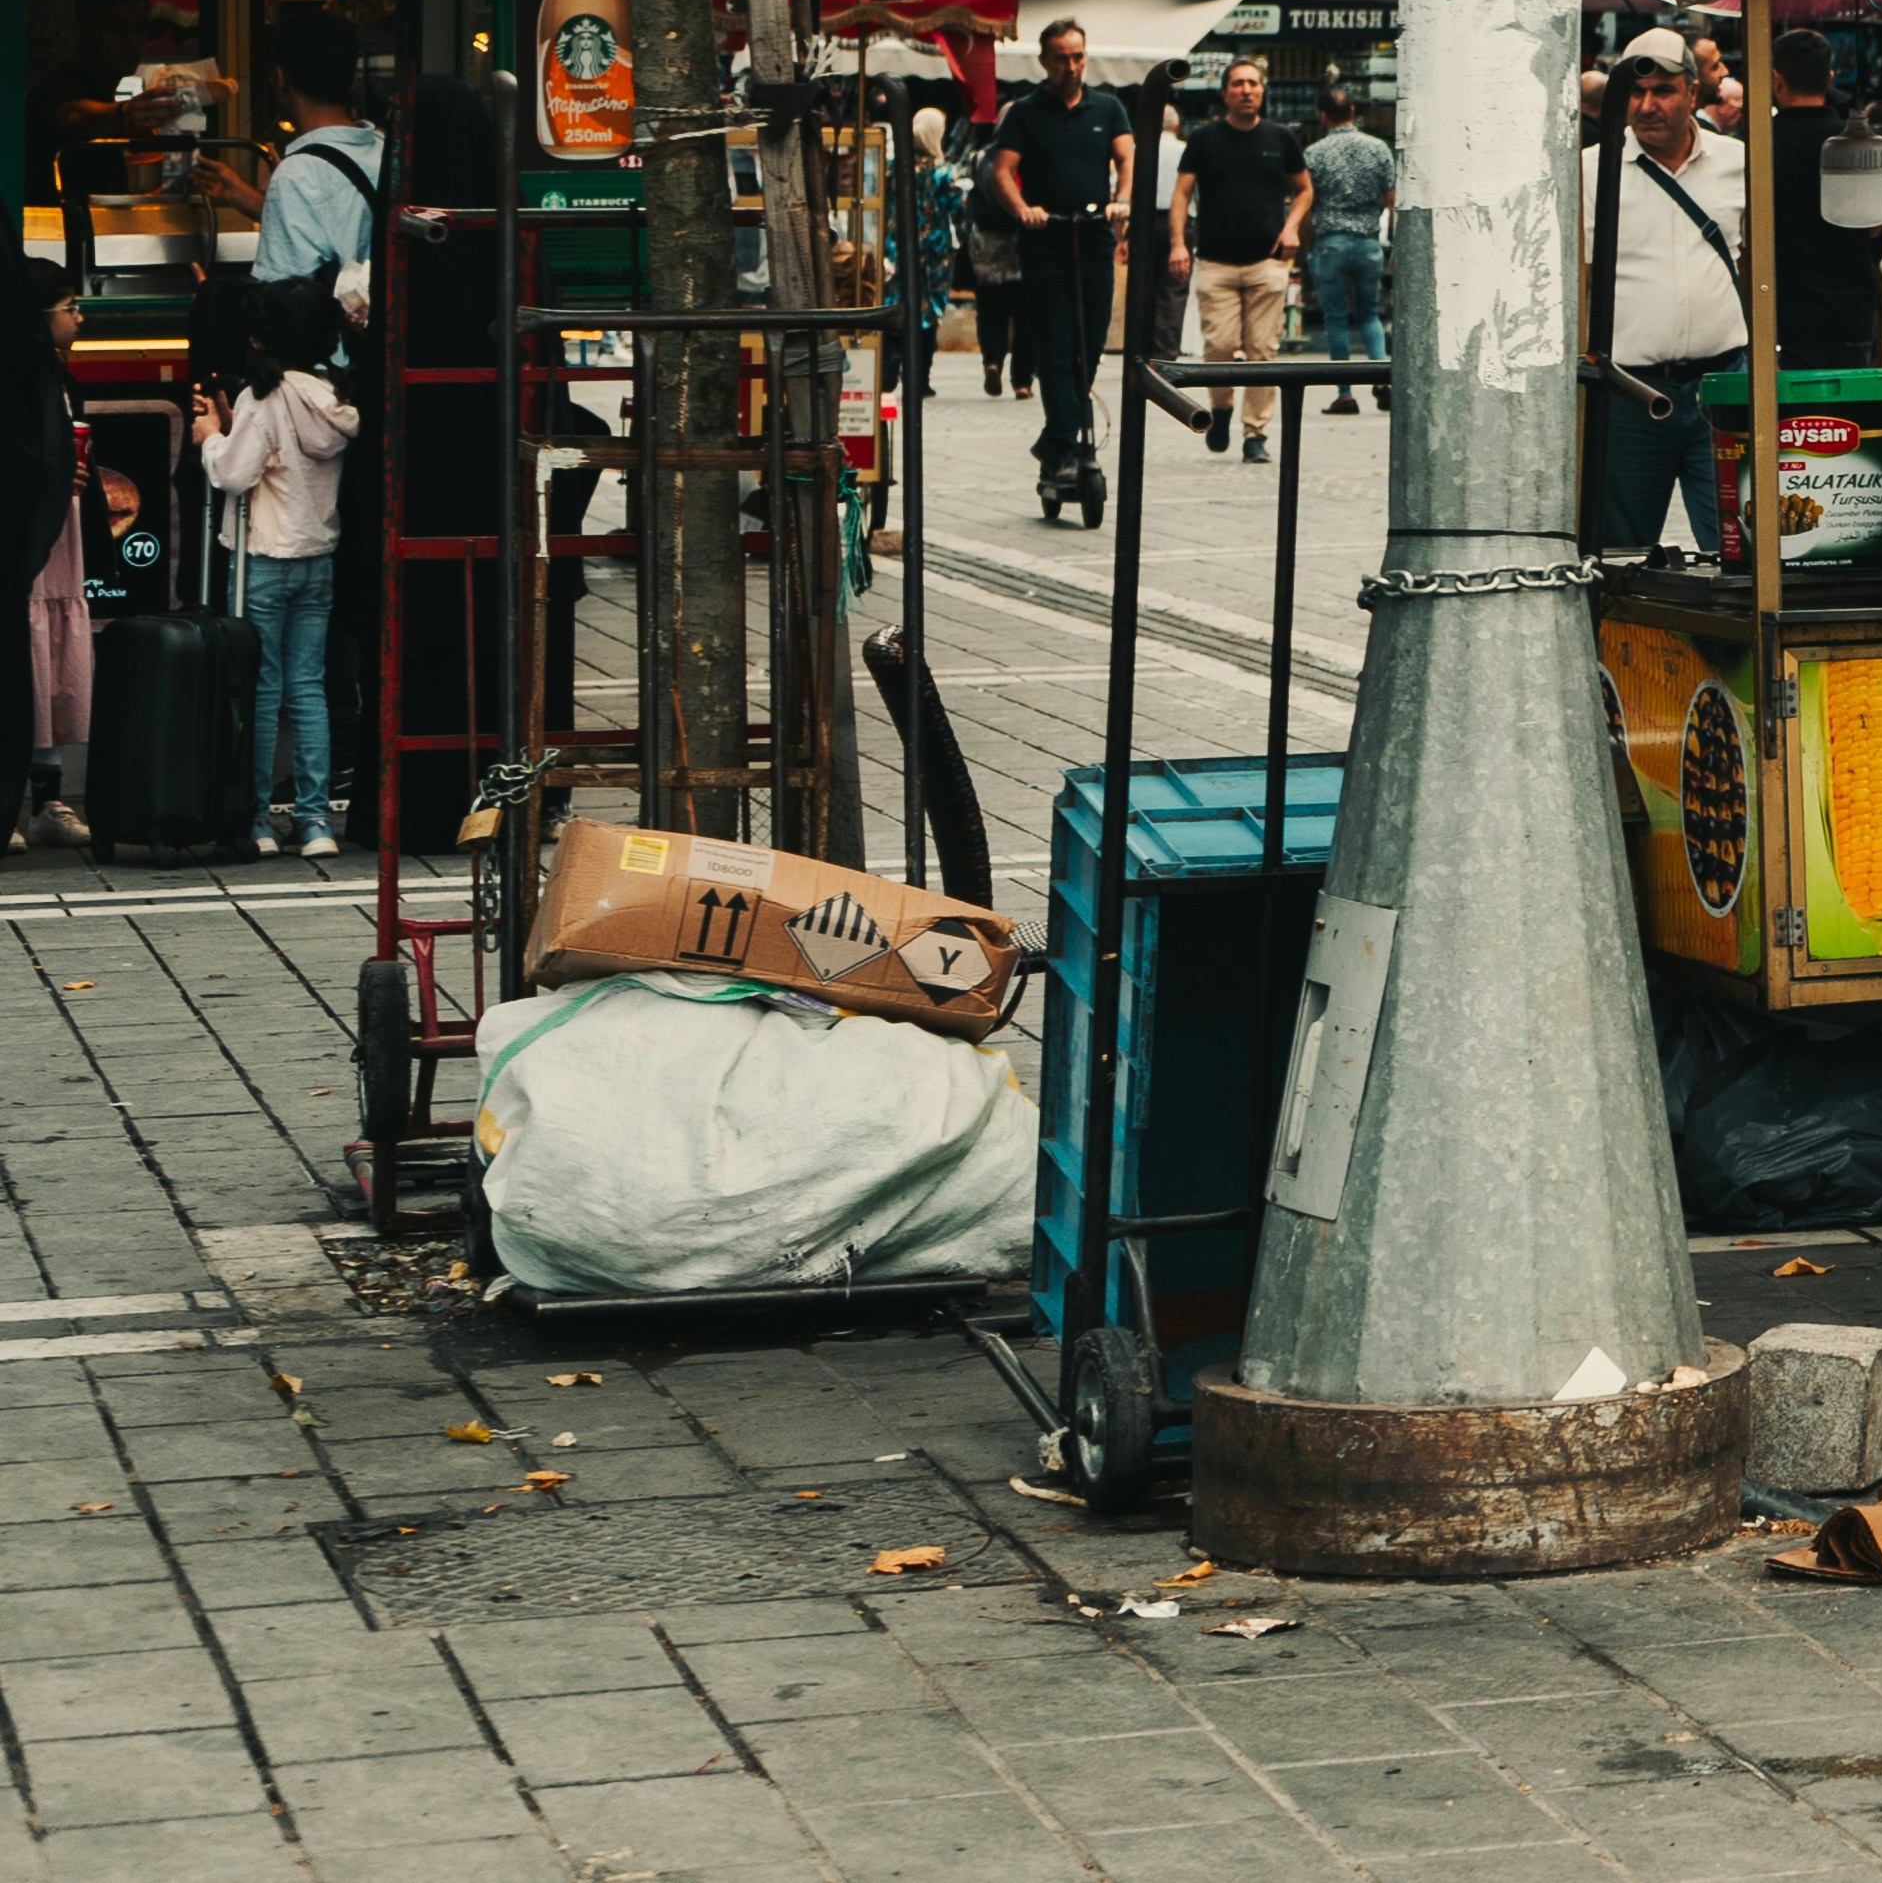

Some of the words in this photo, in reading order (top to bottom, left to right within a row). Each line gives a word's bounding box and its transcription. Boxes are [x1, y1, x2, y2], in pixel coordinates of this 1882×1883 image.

[1289, 9, 1383, 29] TURKISH
[564, 128, 613, 144] 250ml
[1780, 427, 1849, 447] aysan
[937, 945, 963, 976] Y
